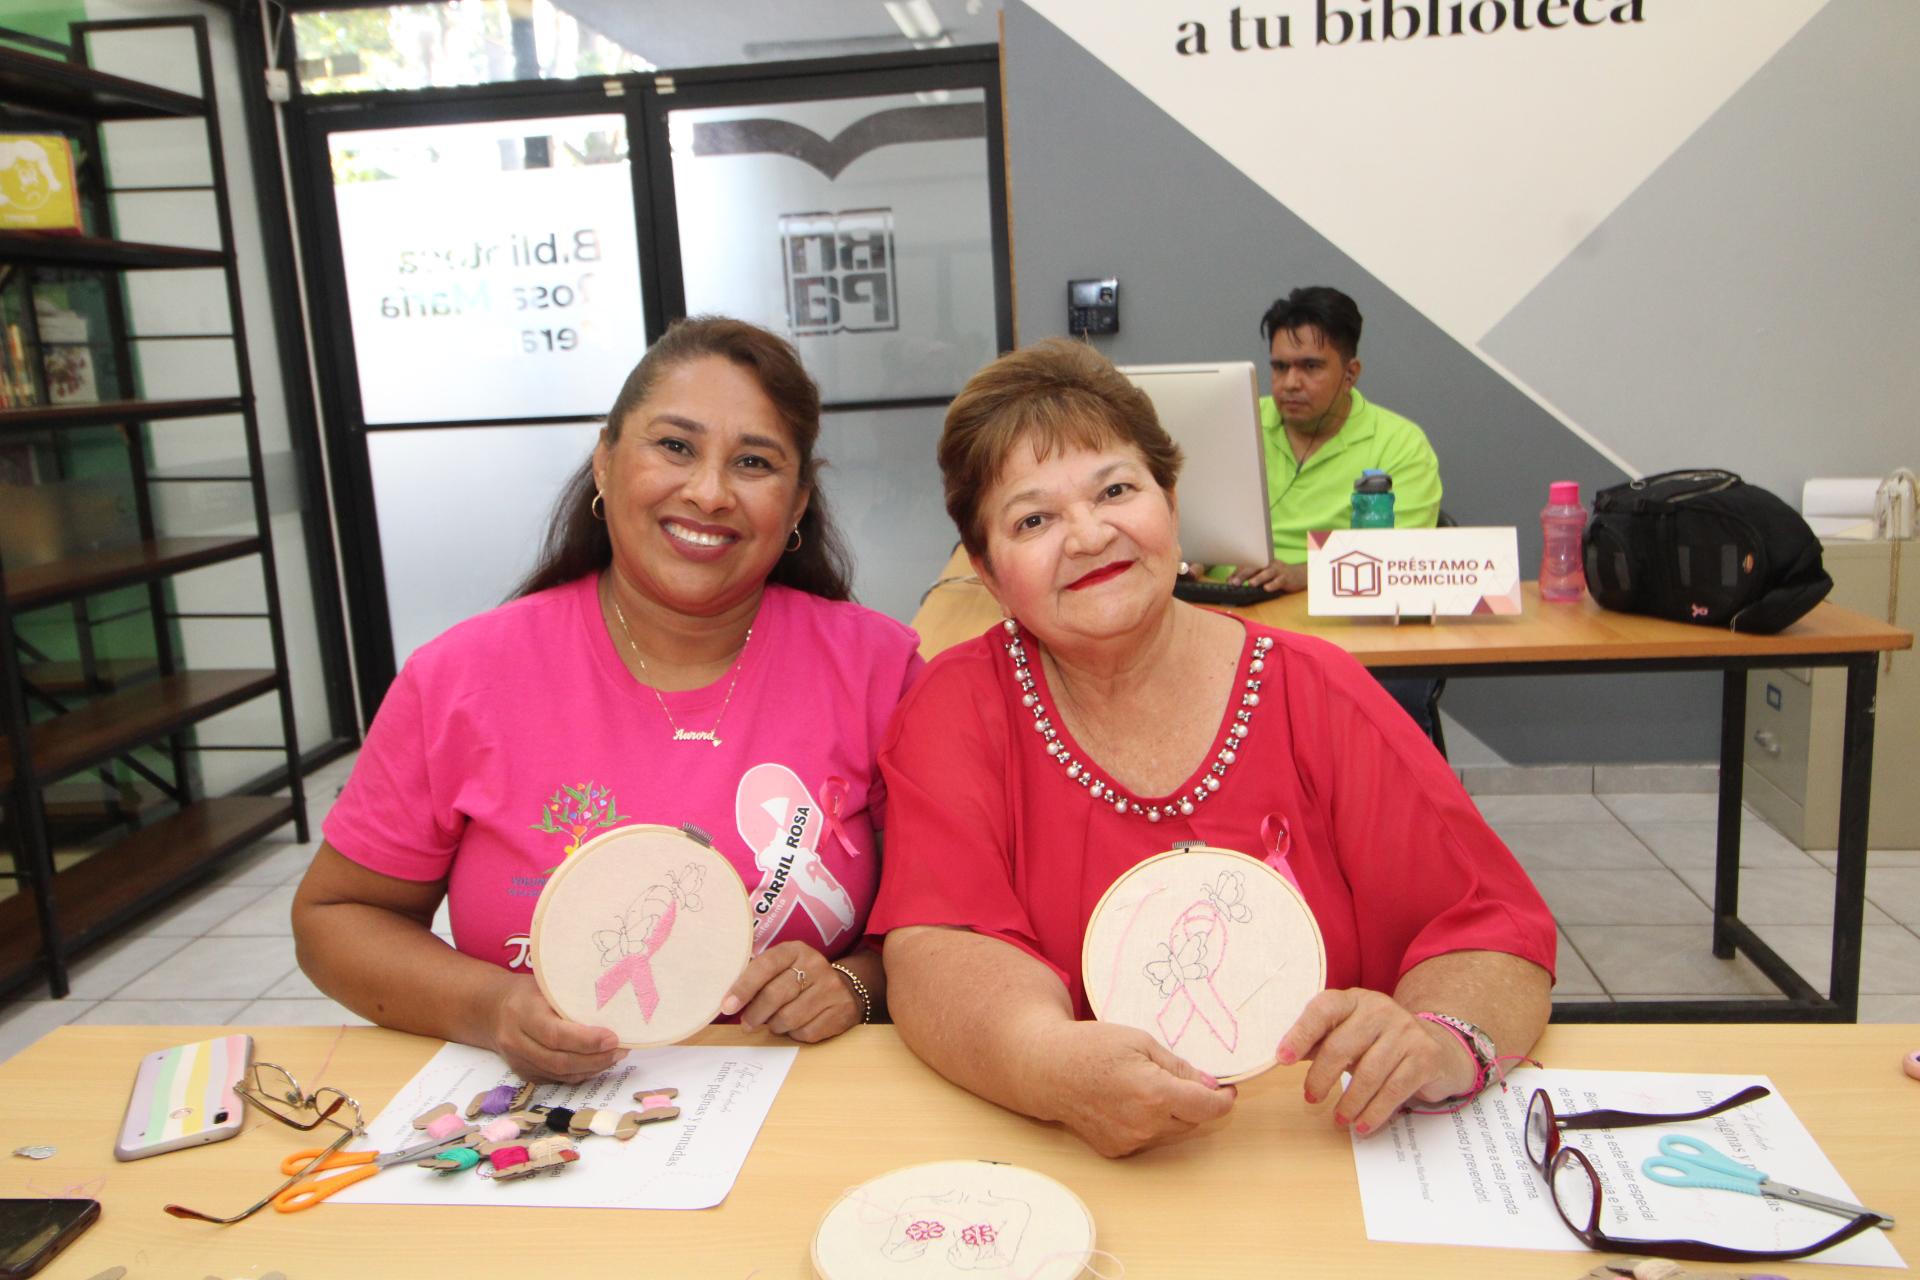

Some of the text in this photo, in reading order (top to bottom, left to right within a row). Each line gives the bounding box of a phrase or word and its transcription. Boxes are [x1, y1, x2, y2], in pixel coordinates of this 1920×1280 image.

[1175, 0, 1647, 56] a tu biblioteca
[1387, 556, 1496, 571] PRÉSTAMO A
[1387, 573, 1478, 586] DOMICILIO
[755, 806, 810, 914] CARRIL ROSA
[1475, 1116, 1490, 1130] por
[1493, 1098, 1510, 1122] sobre
[1505, 1130, 1524, 1158] cáncer
[1515, 1158, 1529, 1170] de
[665, 1124, 697, 1167] puntadas
[1481, 1129, 1498, 1155] unirte
[1491, 1162, 1508, 1181] esta
[1588, 1153, 1604, 1169] con
[1607, 1140, 1624, 1160] este
[1616, 1159, 1636, 1183] taller
[1628, 1183, 1659, 1222] especial
[1494, 1180, 1520, 1216] jornada
